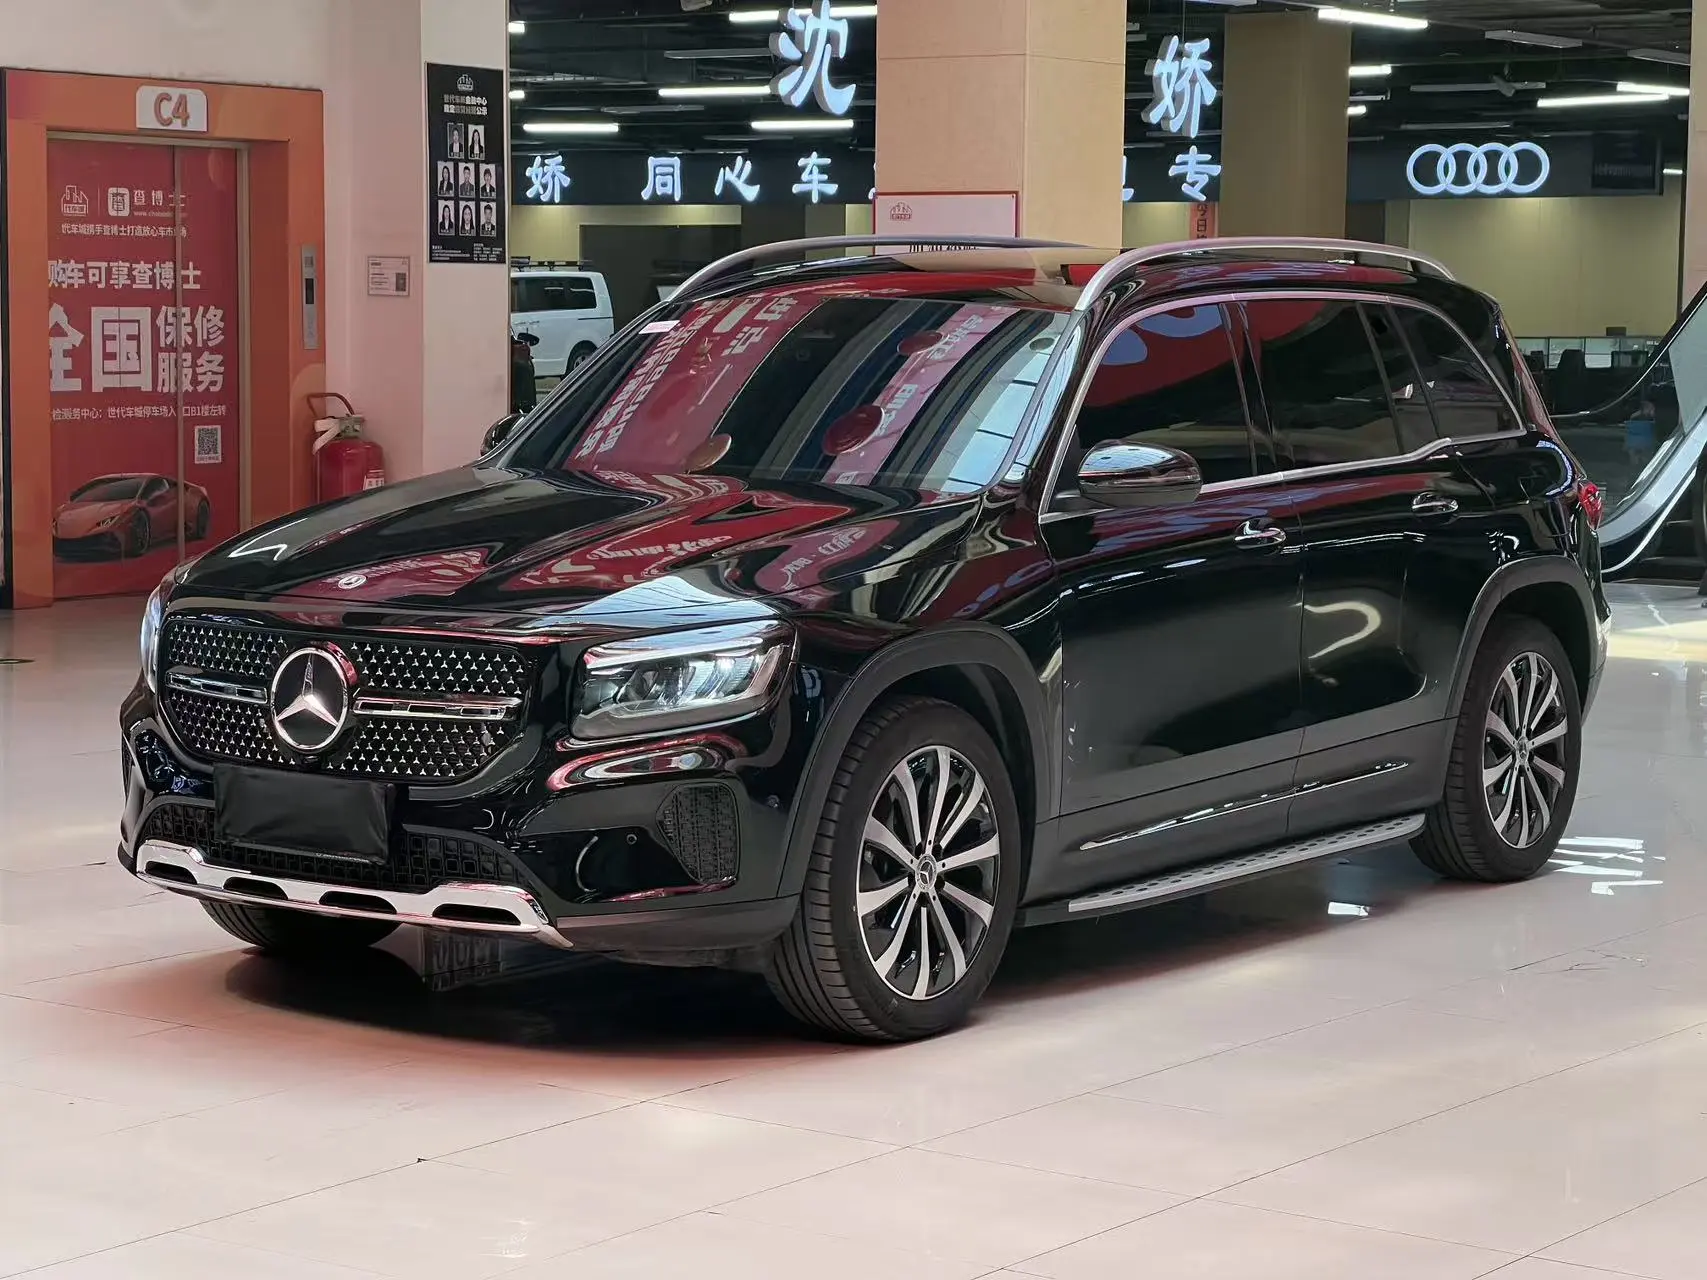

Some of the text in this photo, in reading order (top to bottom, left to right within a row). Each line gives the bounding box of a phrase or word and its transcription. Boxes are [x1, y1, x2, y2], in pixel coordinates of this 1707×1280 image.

[1146, 35, 1217, 138] 娇
[154, 93, 189, 127] C4
[525, 155, 571, 203] 娇
[641, 151, 877, 203] 同心车
[134, 189, 186, 207] 查博士
[48, 259, 201, 290] 购车可享查博士
[156, 305, 225, 347] 保修
[49, 302, 152, 392] 全国
[157, 351, 225, 392] 服务
